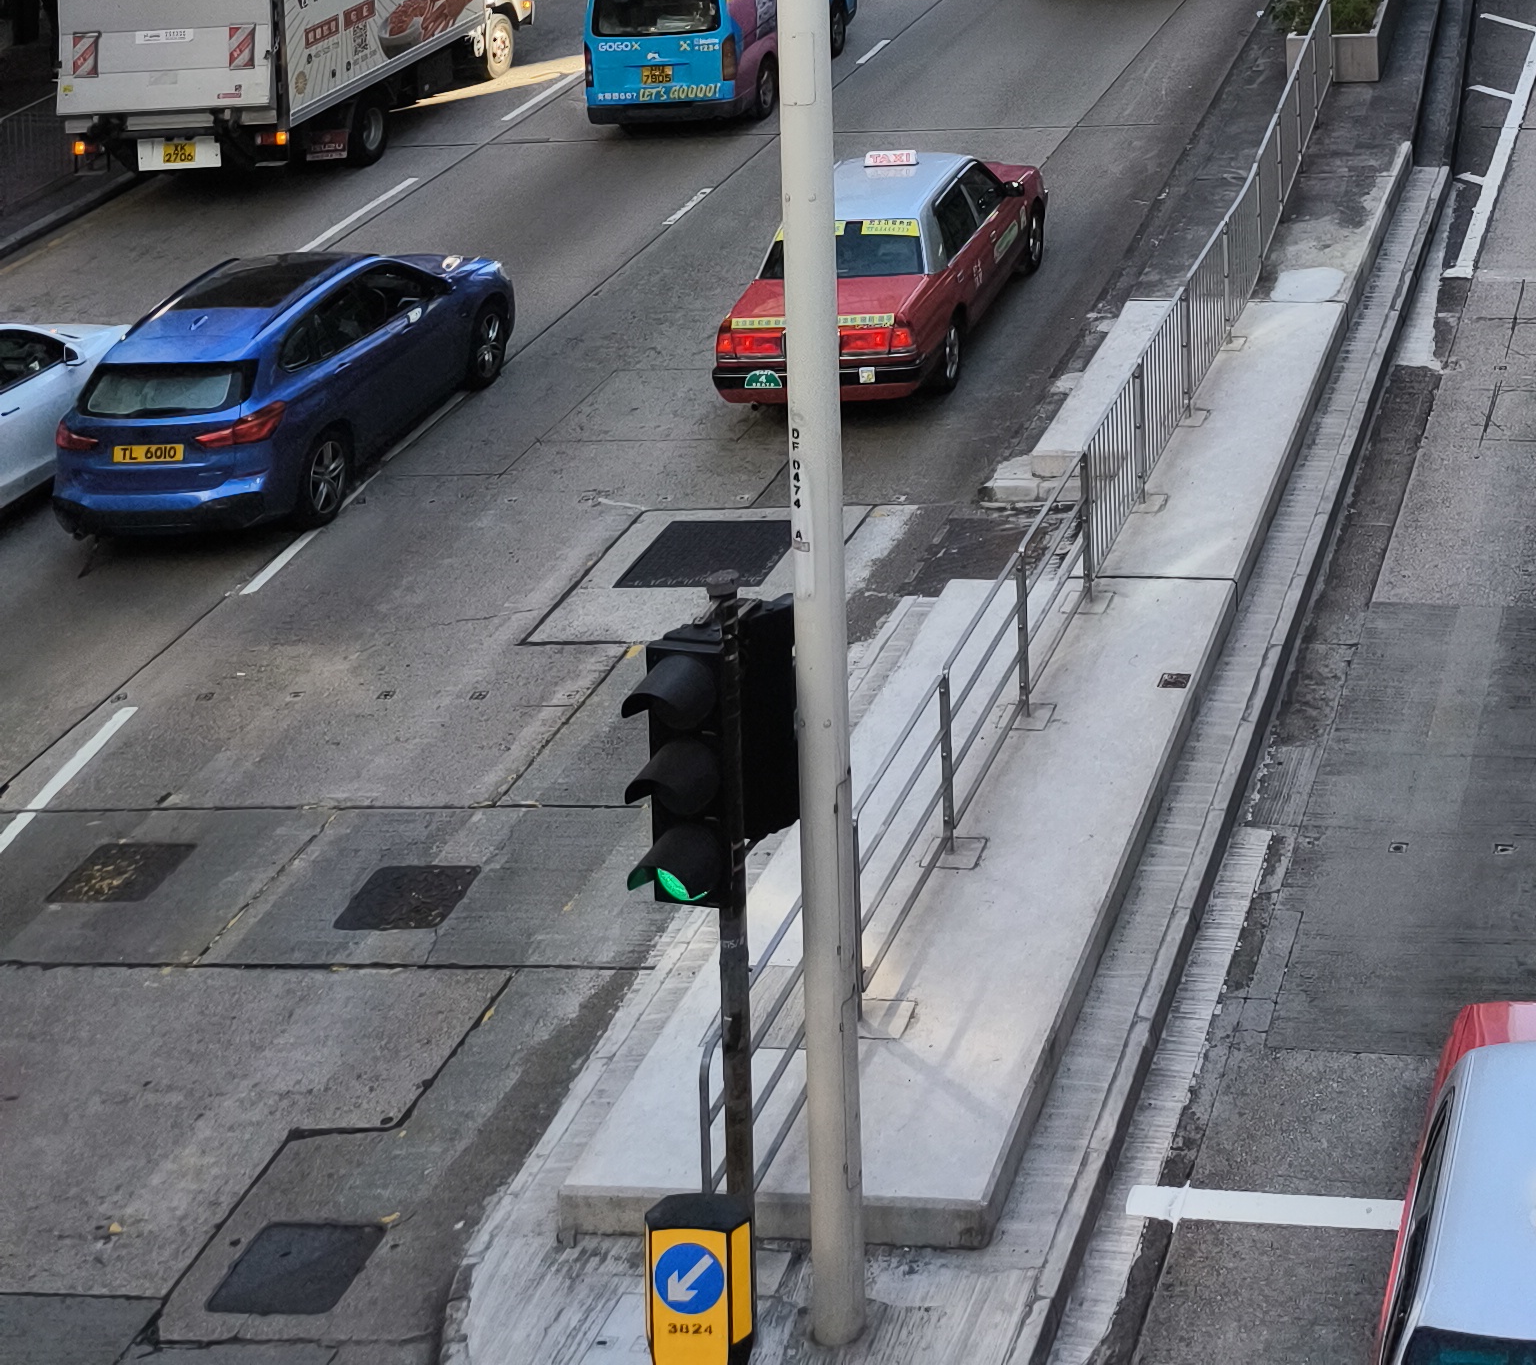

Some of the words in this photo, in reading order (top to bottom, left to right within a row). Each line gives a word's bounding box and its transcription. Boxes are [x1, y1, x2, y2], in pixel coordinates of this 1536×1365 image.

[598, 41, 641, 51] GOGOX
[640, 86, 667, 102] LET'S
[173, 143, 187, 152] XK
[165, 151, 194, 163] 2706
[869, 152, 911, 165] TAXI
[759, 375, 767, 383] 4
[120, 447, 139, 461] TL
[145, 446, 177, 460] 6010
[668, 1322, 713, 1335] 3824
